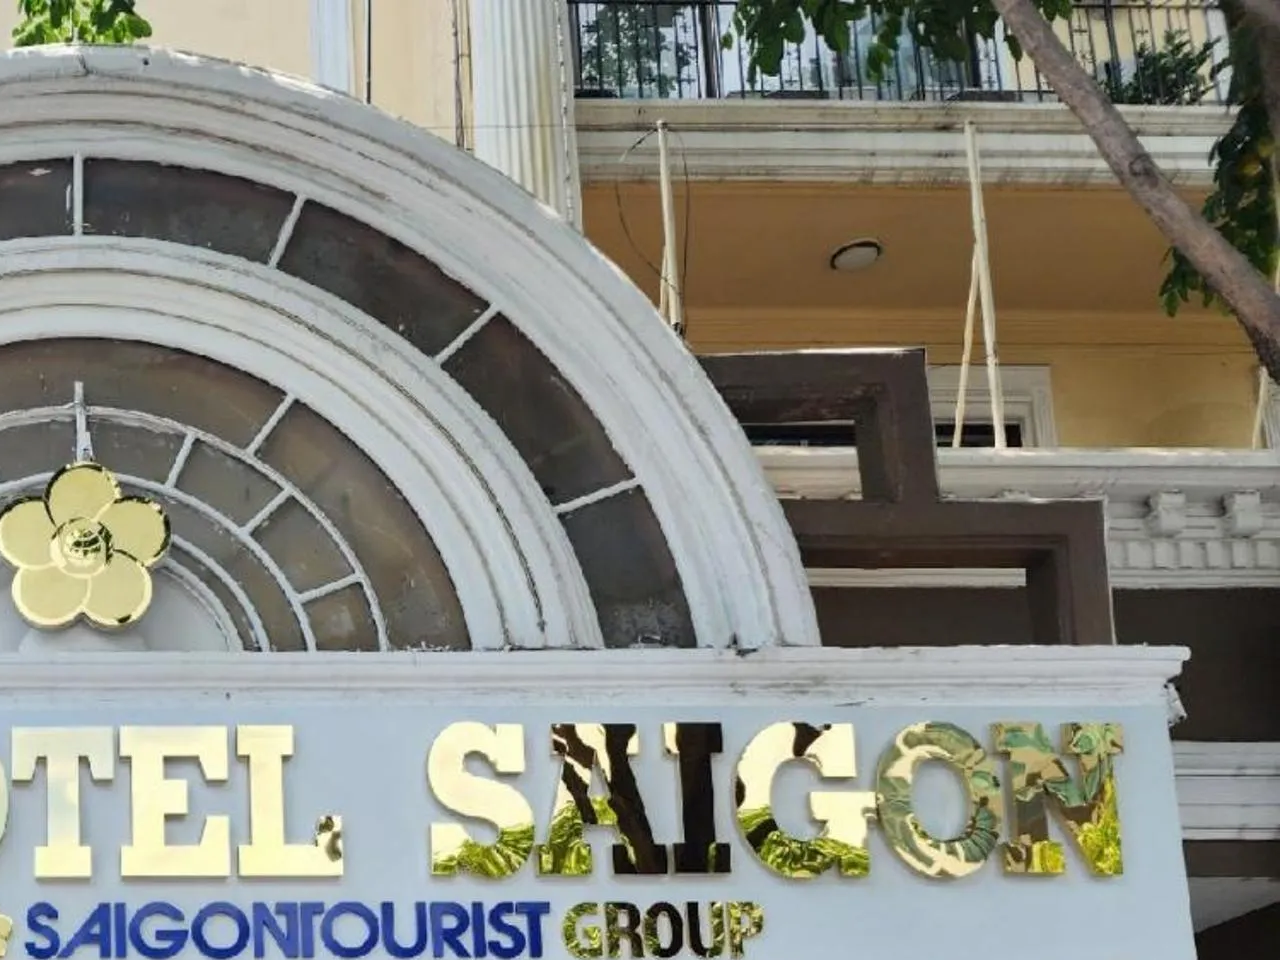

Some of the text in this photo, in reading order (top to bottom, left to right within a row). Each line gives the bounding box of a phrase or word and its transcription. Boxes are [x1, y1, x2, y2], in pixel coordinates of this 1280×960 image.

[426, 721, 1124, 879] SAIGON
[24, 901, 551, 960] SAIGONTOURIST
[562, 901, 764, 960] GROUP
